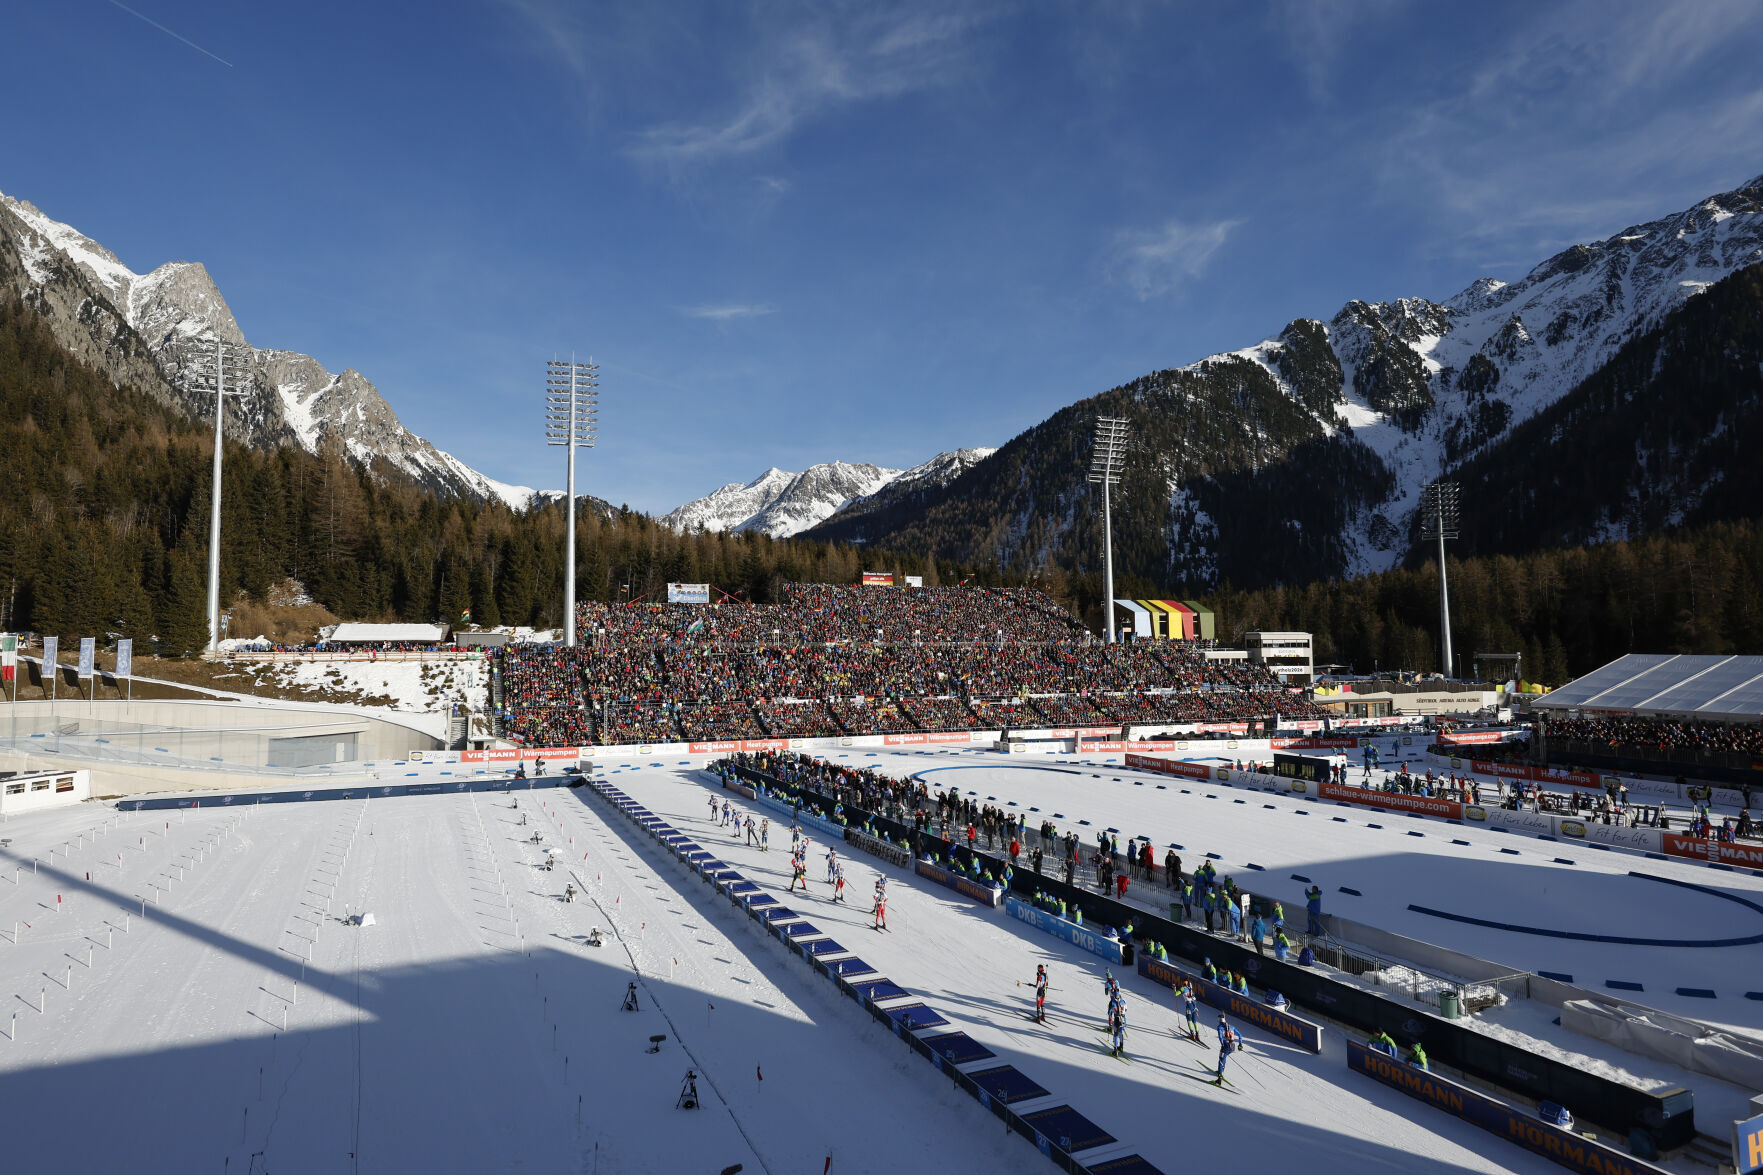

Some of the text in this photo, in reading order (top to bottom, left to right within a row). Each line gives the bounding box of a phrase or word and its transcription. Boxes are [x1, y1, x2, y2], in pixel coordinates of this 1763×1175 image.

[694, 741, 735, 753] VIESSMANN
[1081, 742, 1122, 752] VIESSMANN
[1127, 741, 1173, 751] Wärmepumpen
[466, 750, 516, 762] VIESSMANN
[523, 749, 577, 760] Wärmepumpen
[1128, 756, 1161, 768] VIESSMANN
[1170, 763, 1204, 775] Heat pumps
[1476, 762, 1526, 777] VIESSMANN
[1325, 784, 1450, 814] schlaue-wärmepumpe.com
[1490, 811, 1502, 821] Fit
[1503, 813, 1521, 824] fürs
[1595, 827, 1611, 838] Fit
[1612, 830, 1628, 841] for
[1017, 905, 1036, 927] DKB
[1072, 928, 1095, 951] DKB
[1230, 997, 1303, 1041] HÖRMANN
[1363, 1053, 1464, 1112] HÖRMANN
